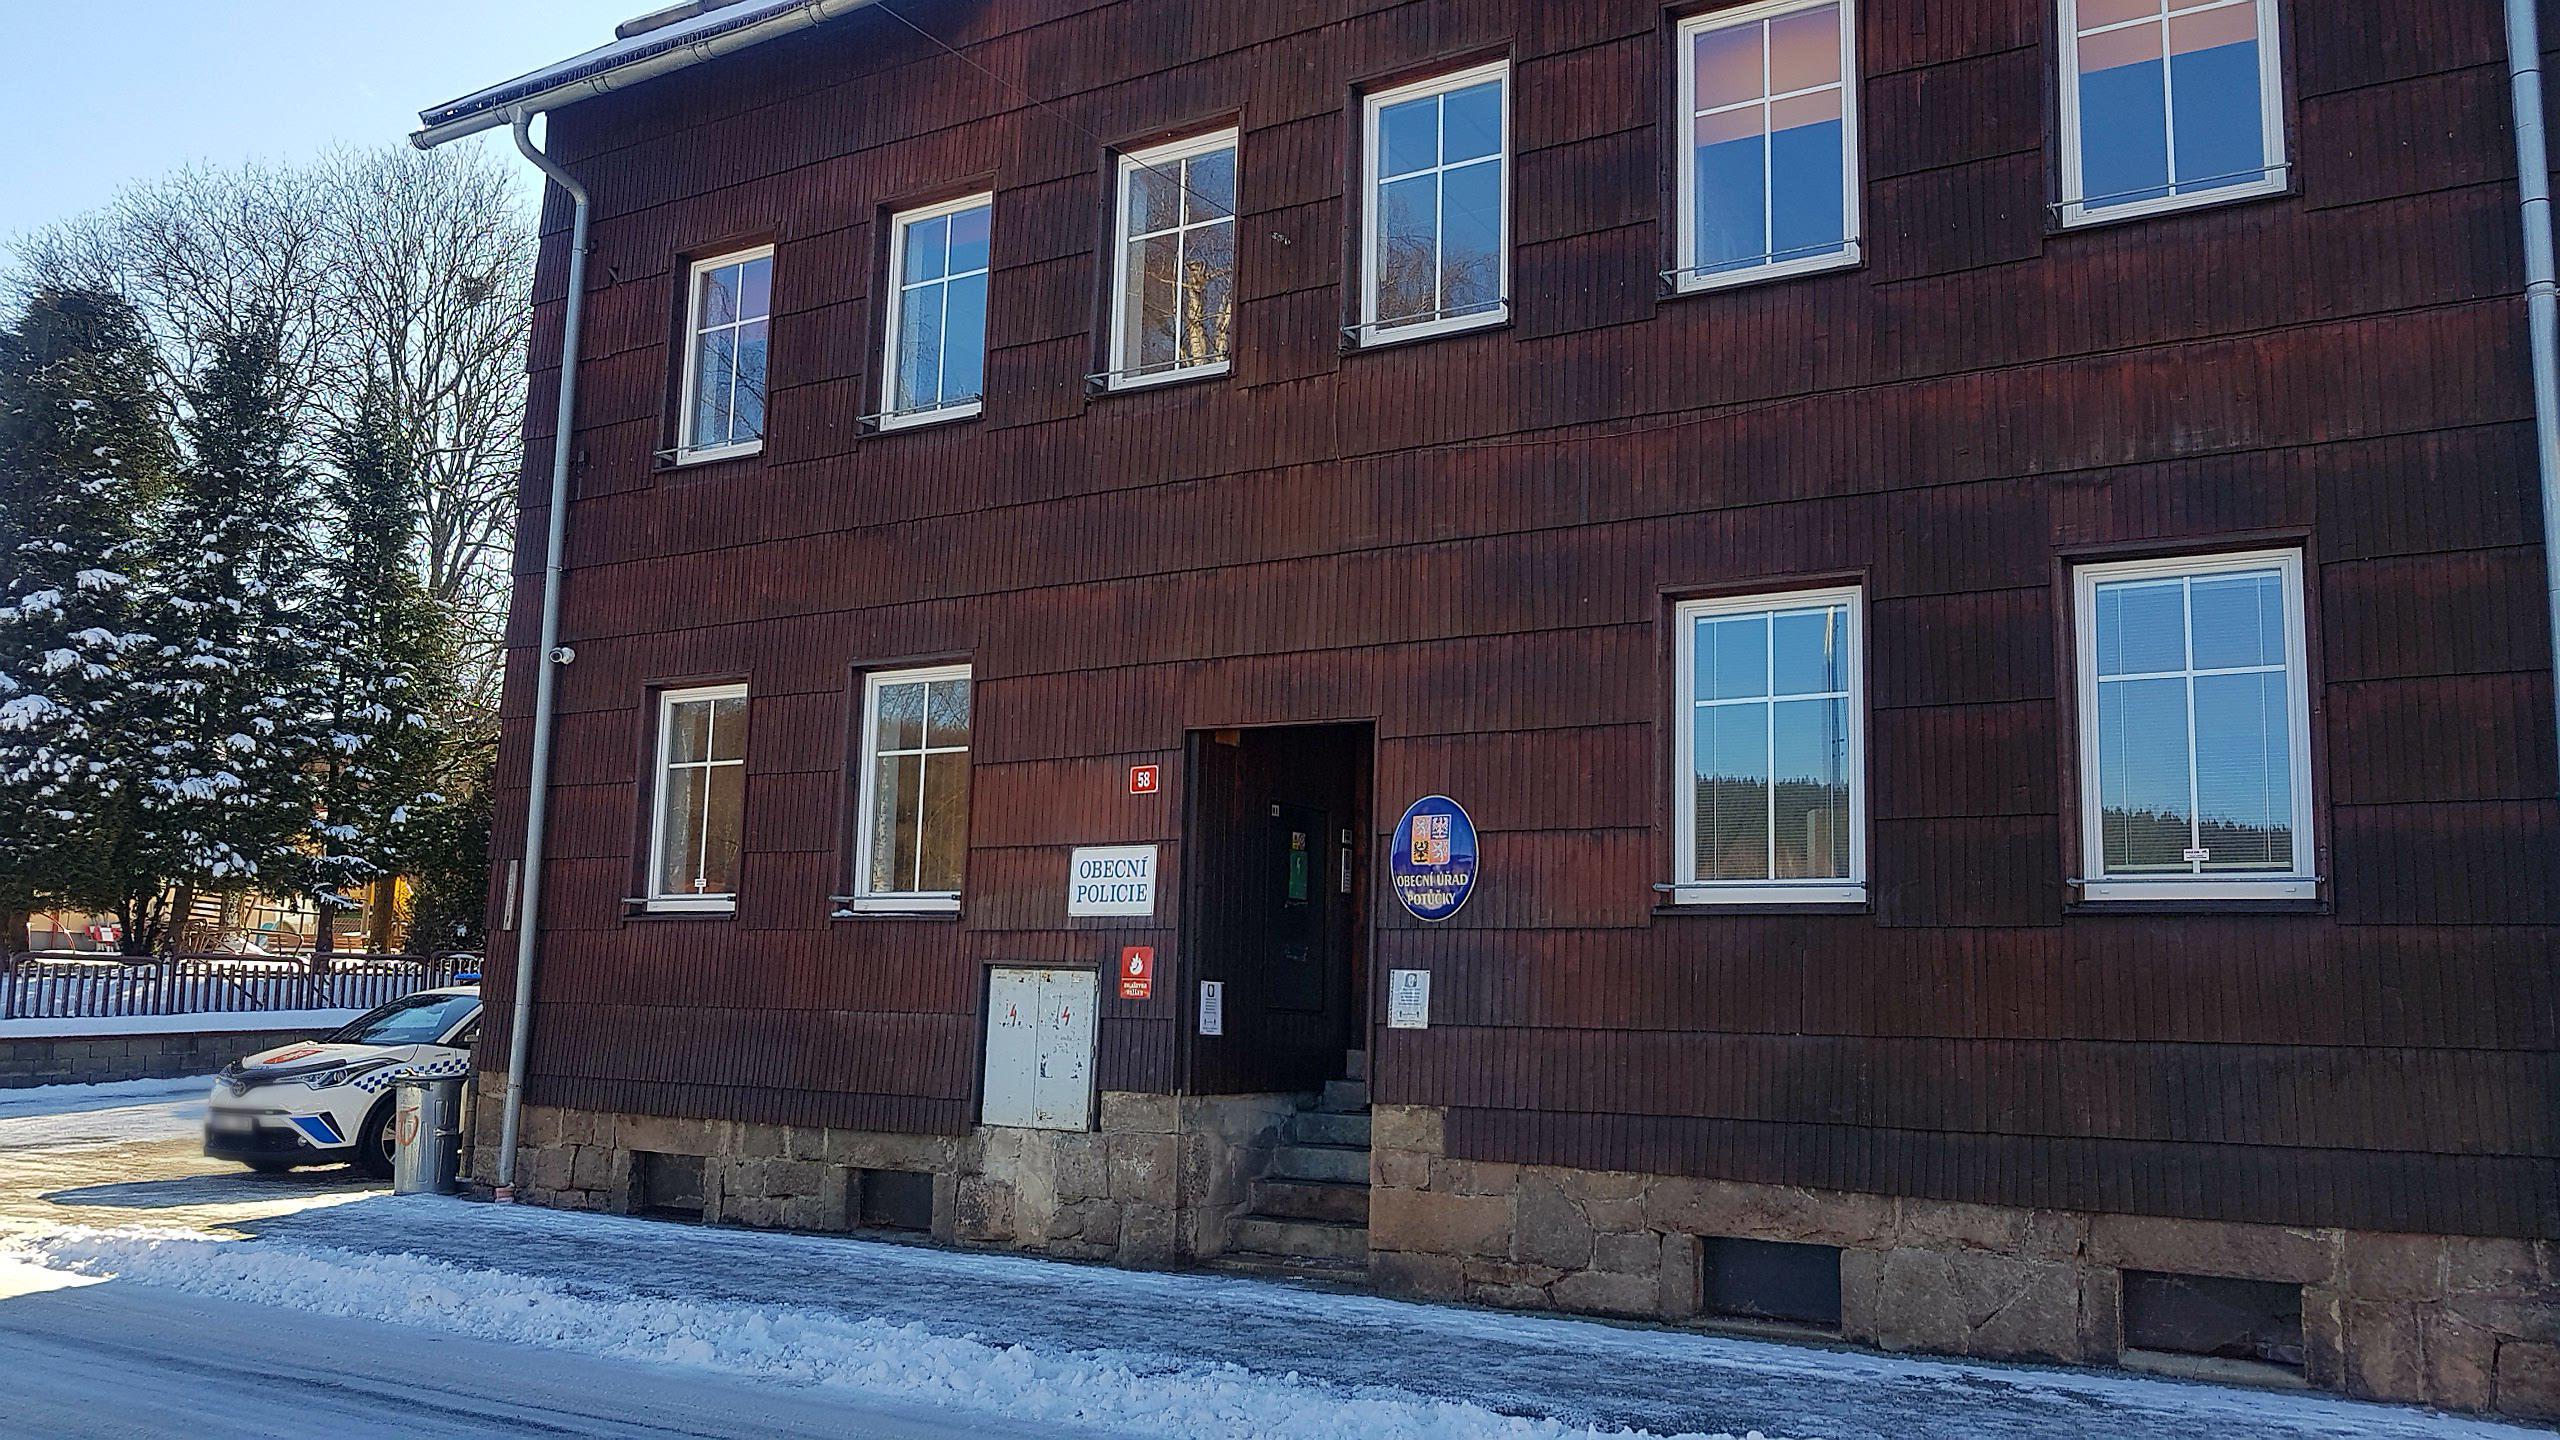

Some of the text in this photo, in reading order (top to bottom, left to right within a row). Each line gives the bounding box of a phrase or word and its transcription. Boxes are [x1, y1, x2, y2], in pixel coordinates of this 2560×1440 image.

[1138, 772, 1150, 787] 58
[1080, 856, 1149, 879] OBECNÍ
[1397, 870, 1468, 887] OBECNÍ ÚŘAD
[1076, 884, 1148, 903] POLICIE
